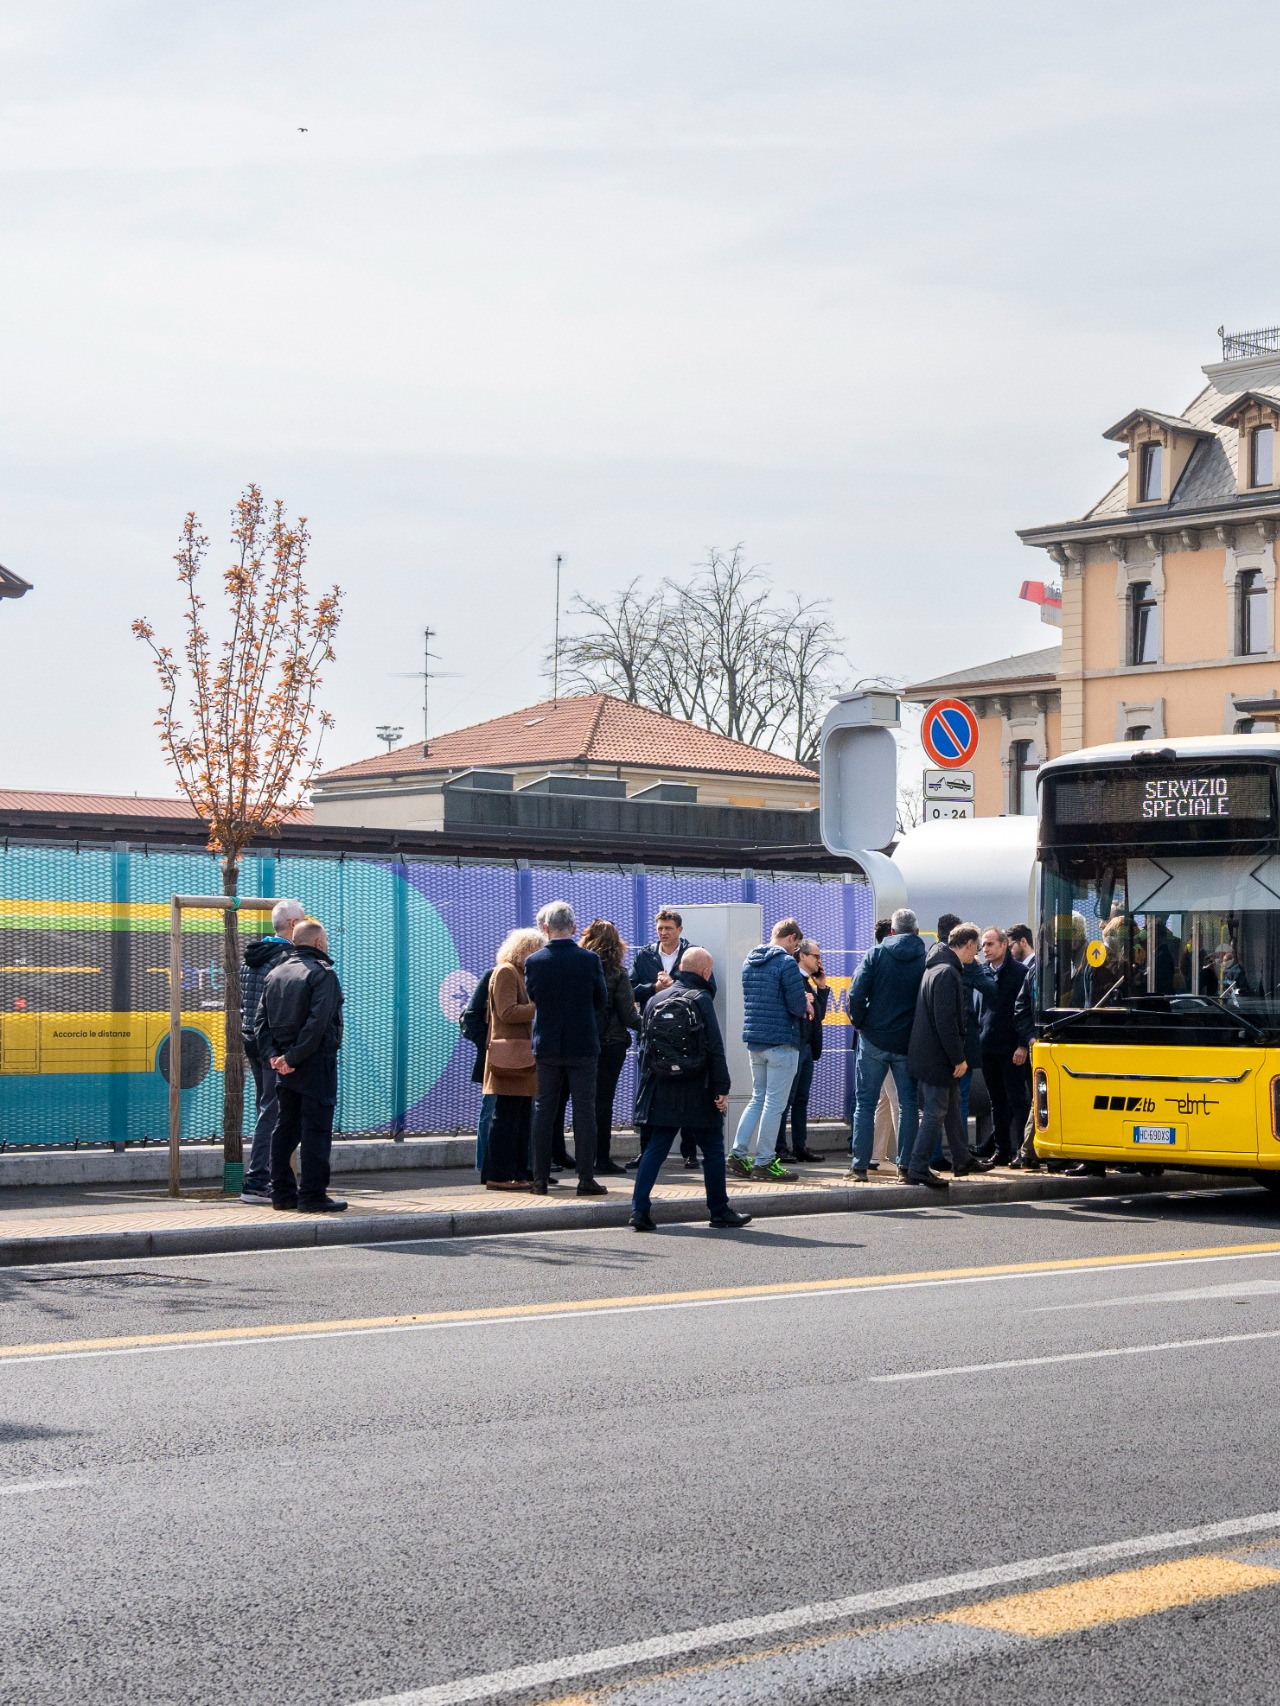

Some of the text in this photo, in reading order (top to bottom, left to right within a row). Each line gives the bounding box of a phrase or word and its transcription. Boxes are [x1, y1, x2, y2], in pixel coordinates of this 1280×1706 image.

[1145, 778, 1227, 798] SERVIZIO
[932, 808, 940, 819] 0
[951, 809, 967, 819] 24
[1142, 797, 1229, 817] SPECIALE
[52, 1030, 131, 1038] Accorcia le distanze
[1165, 1092, 1219, 1115] ebrt
